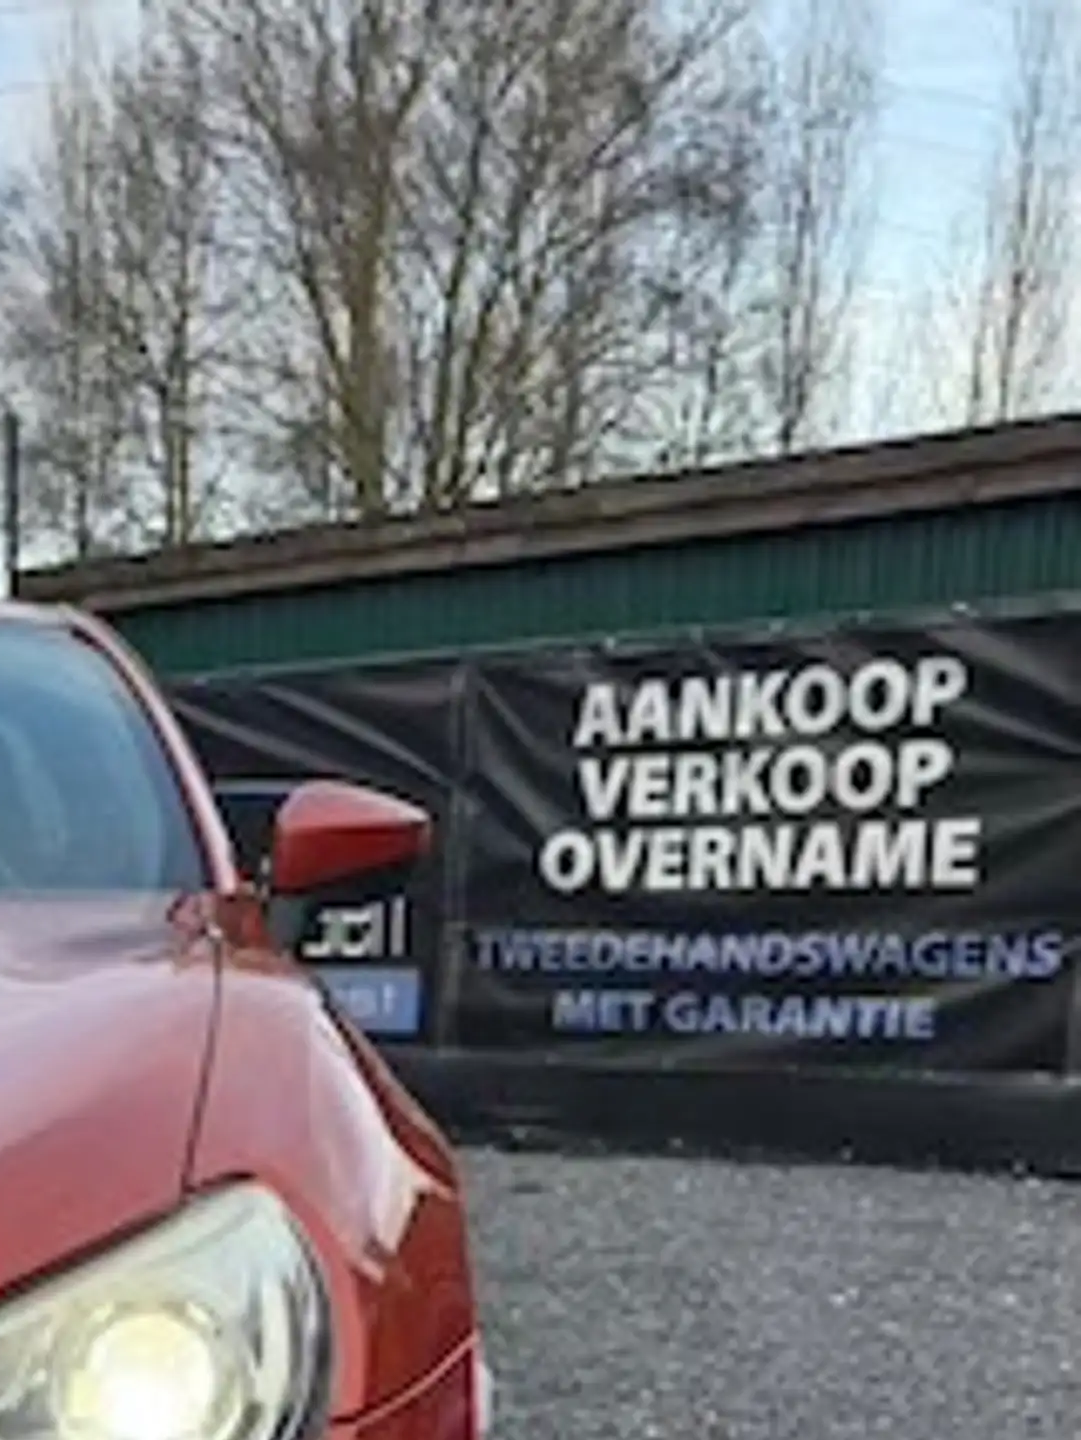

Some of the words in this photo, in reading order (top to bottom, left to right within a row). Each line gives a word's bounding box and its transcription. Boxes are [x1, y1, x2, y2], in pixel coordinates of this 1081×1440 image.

[573, 656, 968, 747] AANKOOP
[578, 739, 954, 819] VERKOOP
[539, 818, 981, 891] OVERNAME
[476, 928, 1062, 978] TWEEDEHANDSWAGENS
[551, 989, 655, 1031] MET
[663, 991, 936, 1039] GARANTIE
